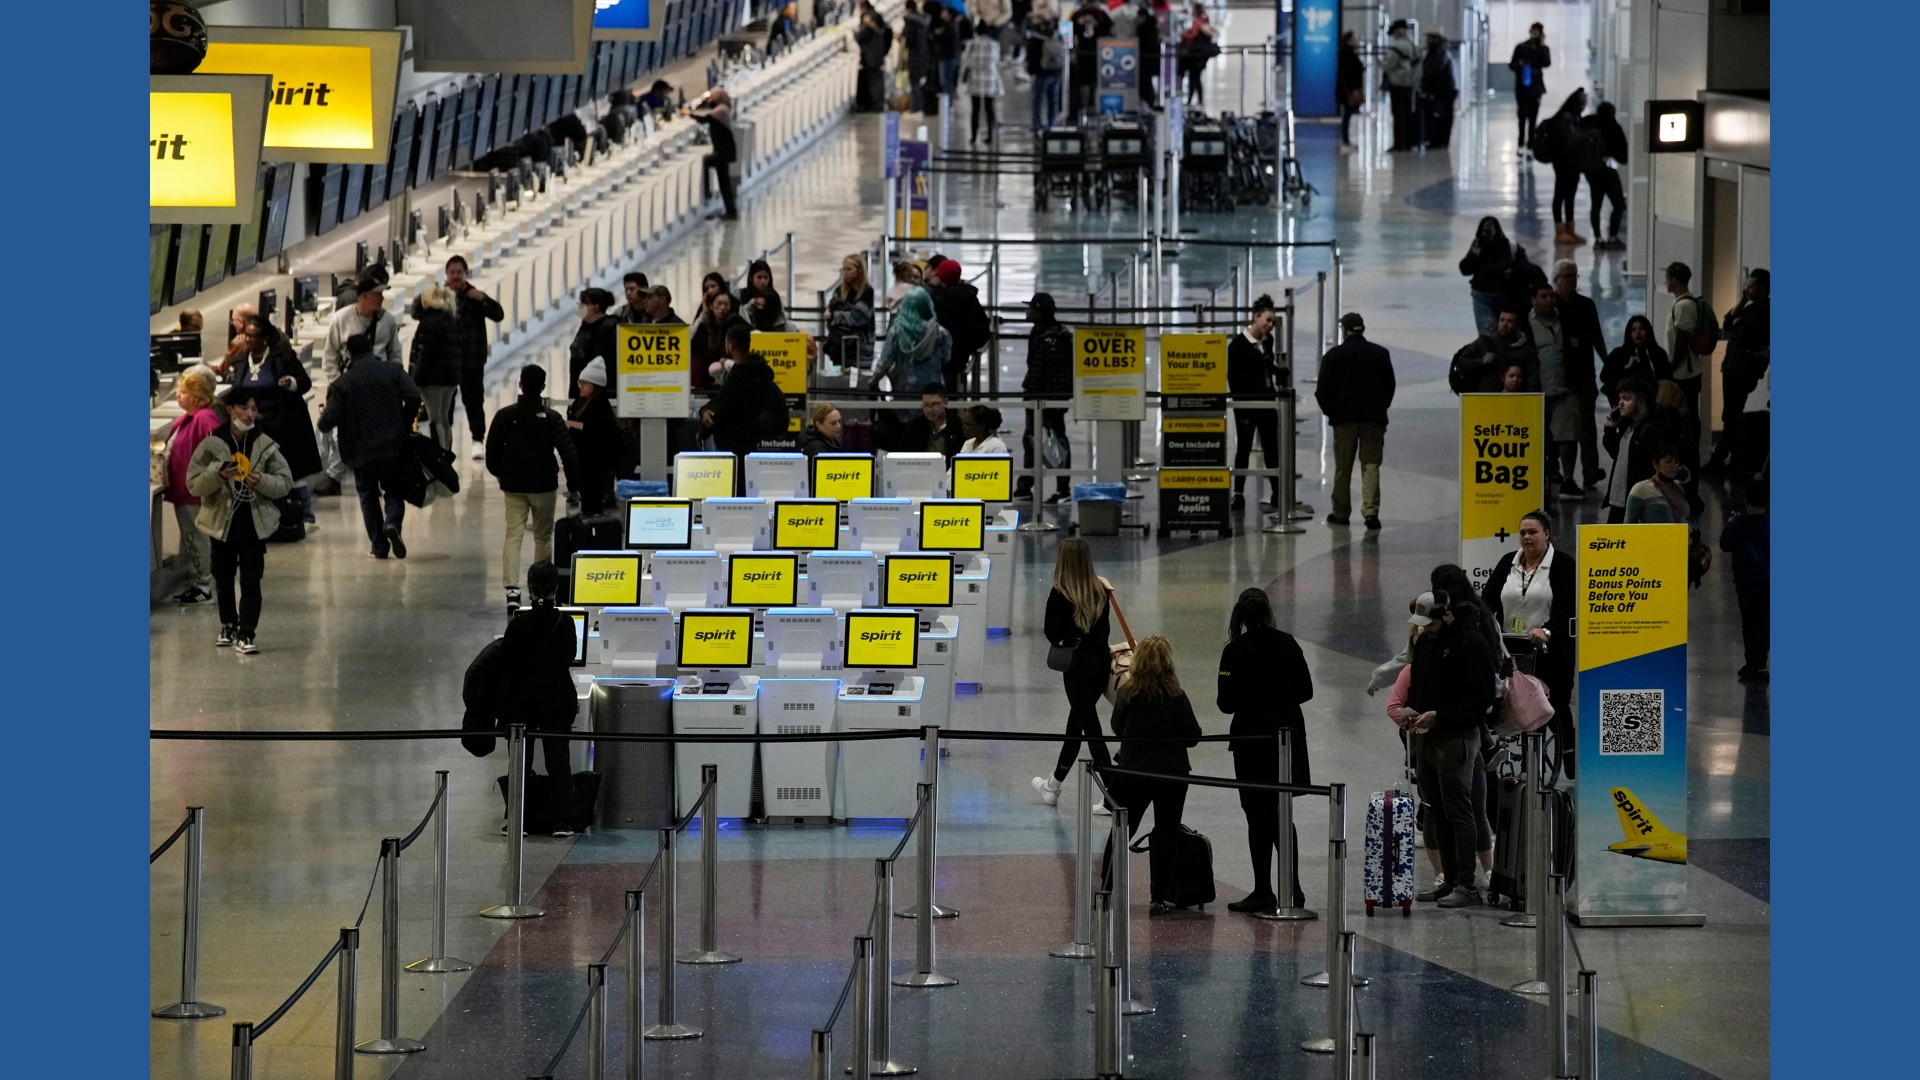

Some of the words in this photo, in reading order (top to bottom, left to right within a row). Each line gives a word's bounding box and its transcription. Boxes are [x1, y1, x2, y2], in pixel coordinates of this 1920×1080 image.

[628, 336, 680, 351] OVER
[1084, 339, 1136, 354] OVER
[628, 354, 644, 365] 40
[648, 354, 680, 365] LBS?
[1167, 351, 1208, 359] Measure
[772, 359, 796, 369] Bags
[1084, 357, 1100, 368] 40
[1104, 357, 1136, 368] LBS?
[1167, 361, 1190, 369] Your
[1192, 361, 1216, 371] Bags
[1474, 424, 1529, 438] Self-Tag
[761, 439, 796, 448] Included
[1168, 441, 1185, 449] One
[1186, 440, 1220, 449] Included
[1473, 438, 1530, 458] Your
[686, 469, 722, 480] spirit
[826, 471, 861, 482] spirit
[964, 471, 1000, 482] spirit
[1475, 460, 1529, 490] Bag
[1178, 494, 1210, 506] Charge
[1178, 504, 1211, 514] Applies
[788, 516, 824, 528] spirit
[933, 516, 970, 528] spirit
[1589, 540, 1627, 551] spirit
[585, 570, 626, 583] spirit
[742, 570, 782, 583] spirit
[898, 571, 938, 584] spirit
[1588, 567, 1617, 577] Land
[1618, 567, 1640, 577] 500
[1588, 580, 1623, 589] Bonus
[1626, 578, 1662, 588] Points
[1588, 591, 1626, 601] Before
[1628, 591, 1648, 600] You
[1588, 603, 1614, 613] Take
[1618, 602, 1636, 613] Off
[694, 629, 736, 643] spirit
[860, 630, 902, 643] spirit
[1614, 790, 1652, 836] spirit
